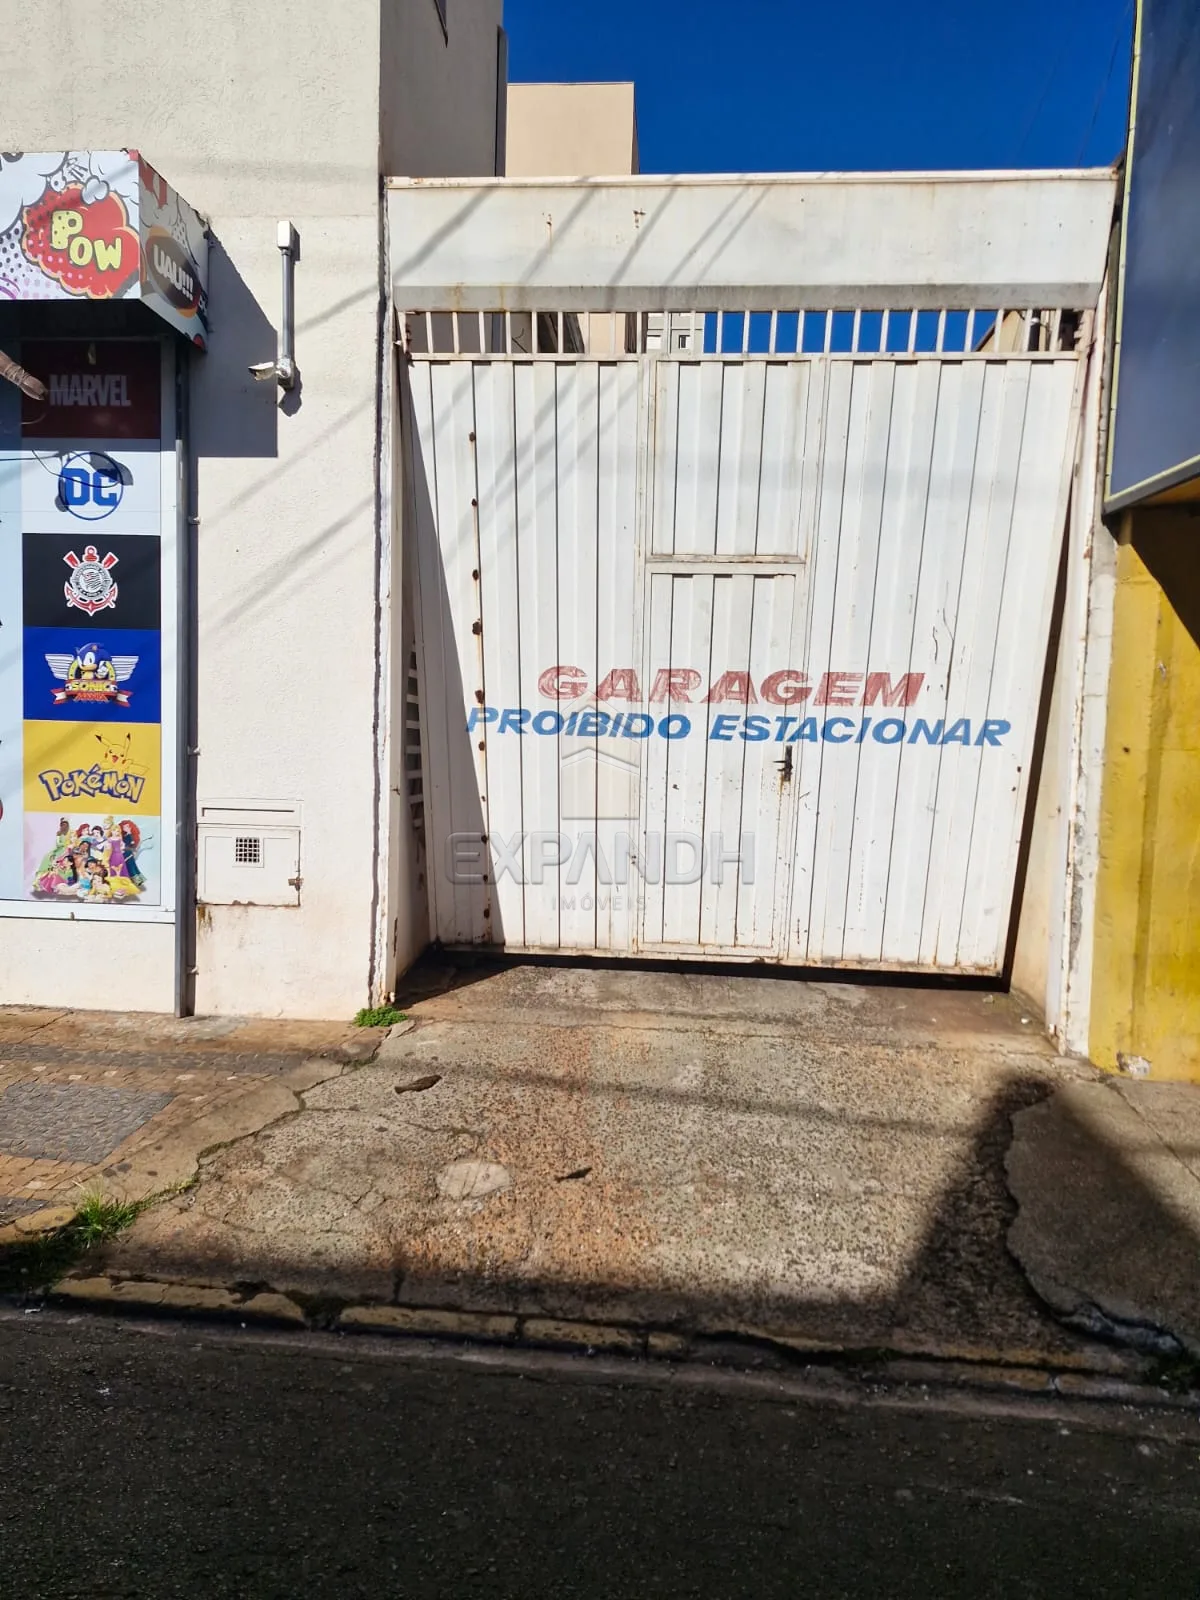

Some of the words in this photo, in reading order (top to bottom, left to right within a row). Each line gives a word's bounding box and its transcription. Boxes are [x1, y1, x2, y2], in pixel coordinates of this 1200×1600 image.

[50, 210, 123, 272] POW
[50, 373, 131, 406] MARVEL
[62, 467, 118, 506] DC
[537, 664, 926, 707] GARAGEM
[466, 706, 691, 741] PROIBIDO
[710, 713, 1011, 748] ESTACIONAR
